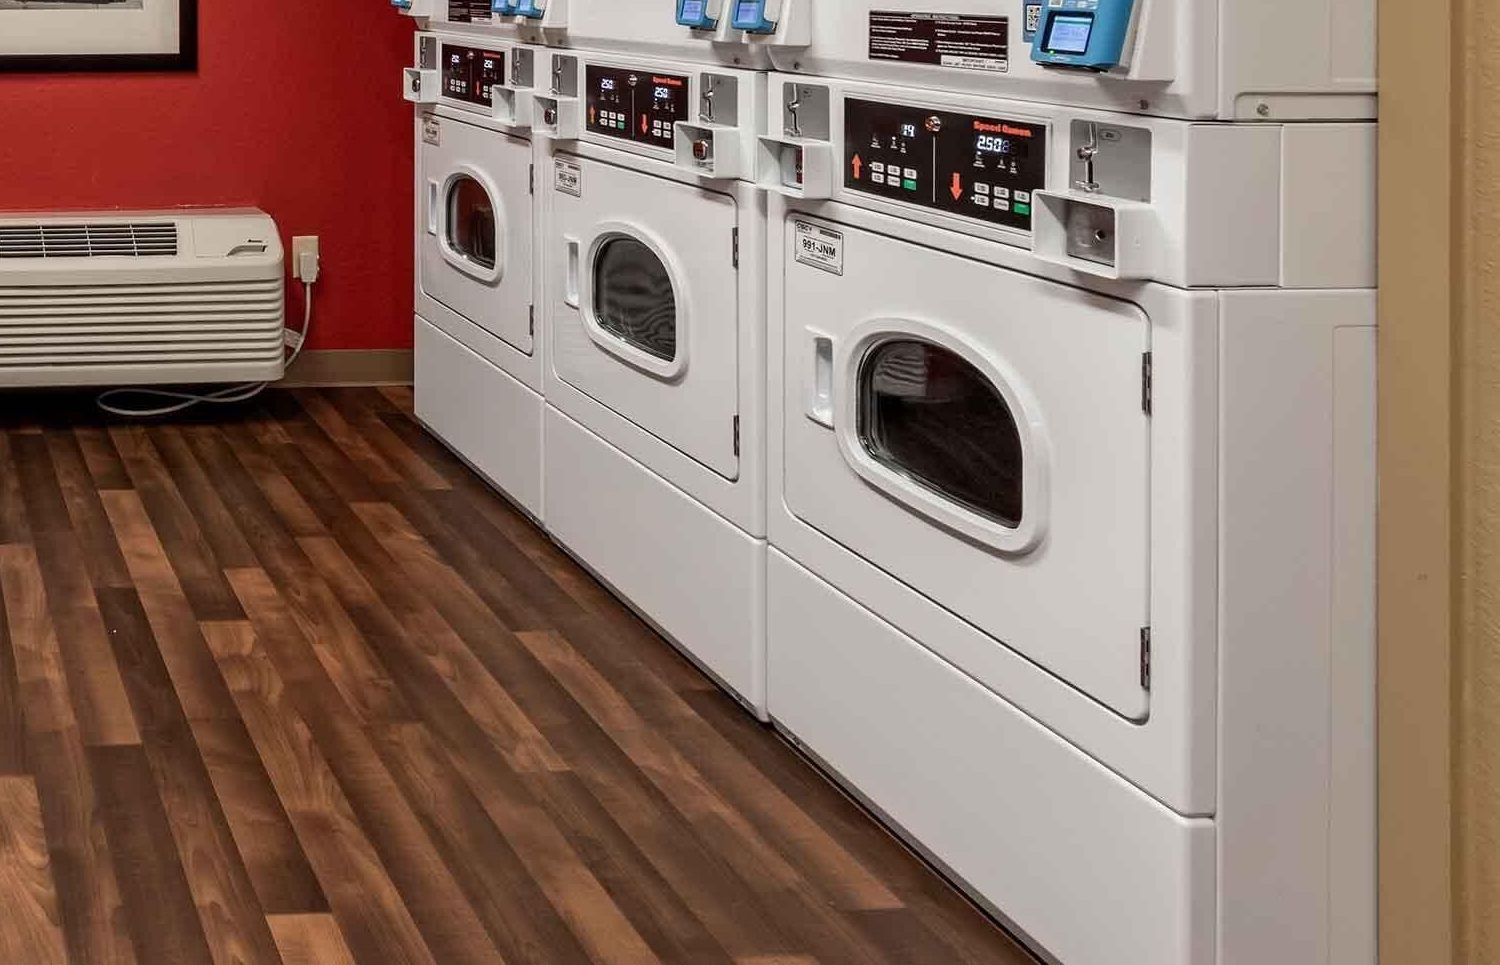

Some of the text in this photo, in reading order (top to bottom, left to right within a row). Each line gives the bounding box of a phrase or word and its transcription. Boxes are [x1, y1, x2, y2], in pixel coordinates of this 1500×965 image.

[973, 120, 1032, 137] Speed Queen
[802, 238, 836, 257] 991-JNM
